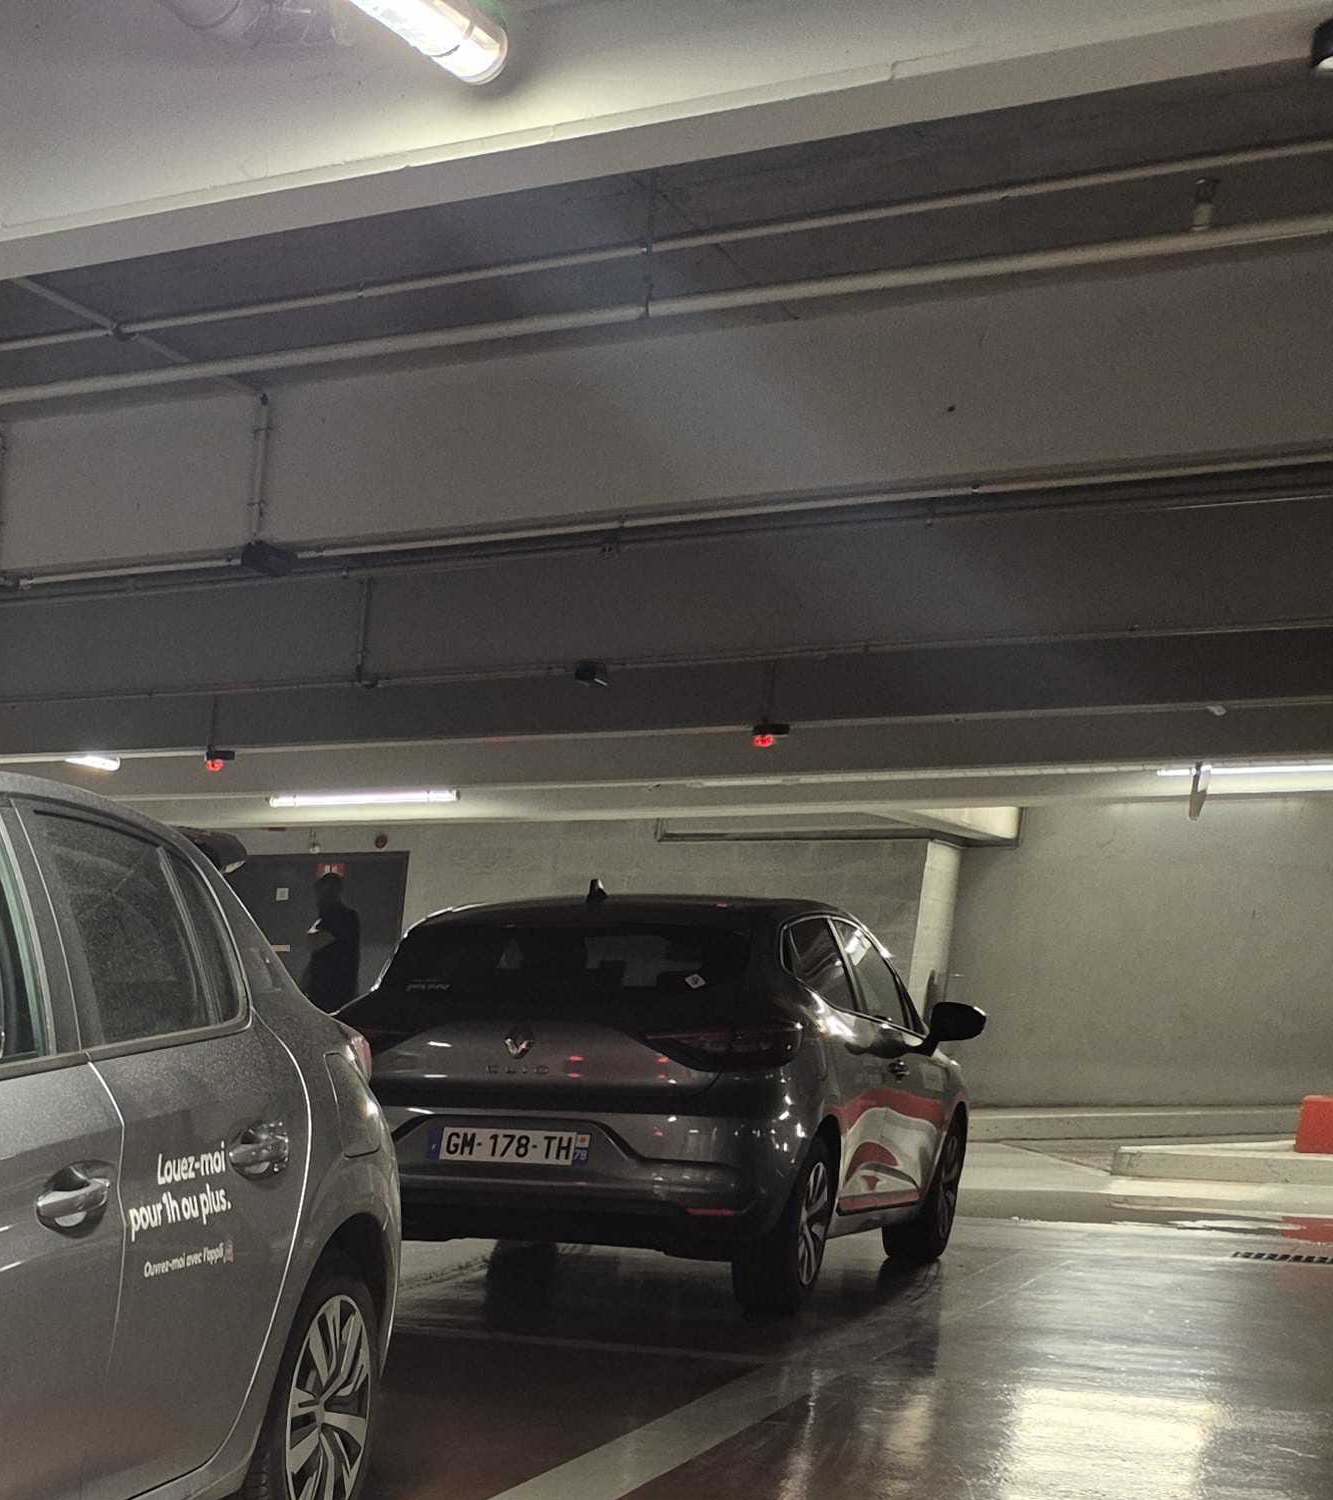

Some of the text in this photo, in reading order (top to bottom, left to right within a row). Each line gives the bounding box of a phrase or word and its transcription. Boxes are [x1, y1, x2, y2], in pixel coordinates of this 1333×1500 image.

[486, 1064, 549, 1074] CLIO
[445, 1131, 573, 1160] GM-178-TH
[573, 1149, 588, 1161] 78
[157, 1140, 226, 1185] Louez-moi
[129, 1183, 232, 1242] pour 1h ou plus.
[144, 1251, 186, 1278] Ouvrez-moi
[186, 1252, 203, 1267] avec
